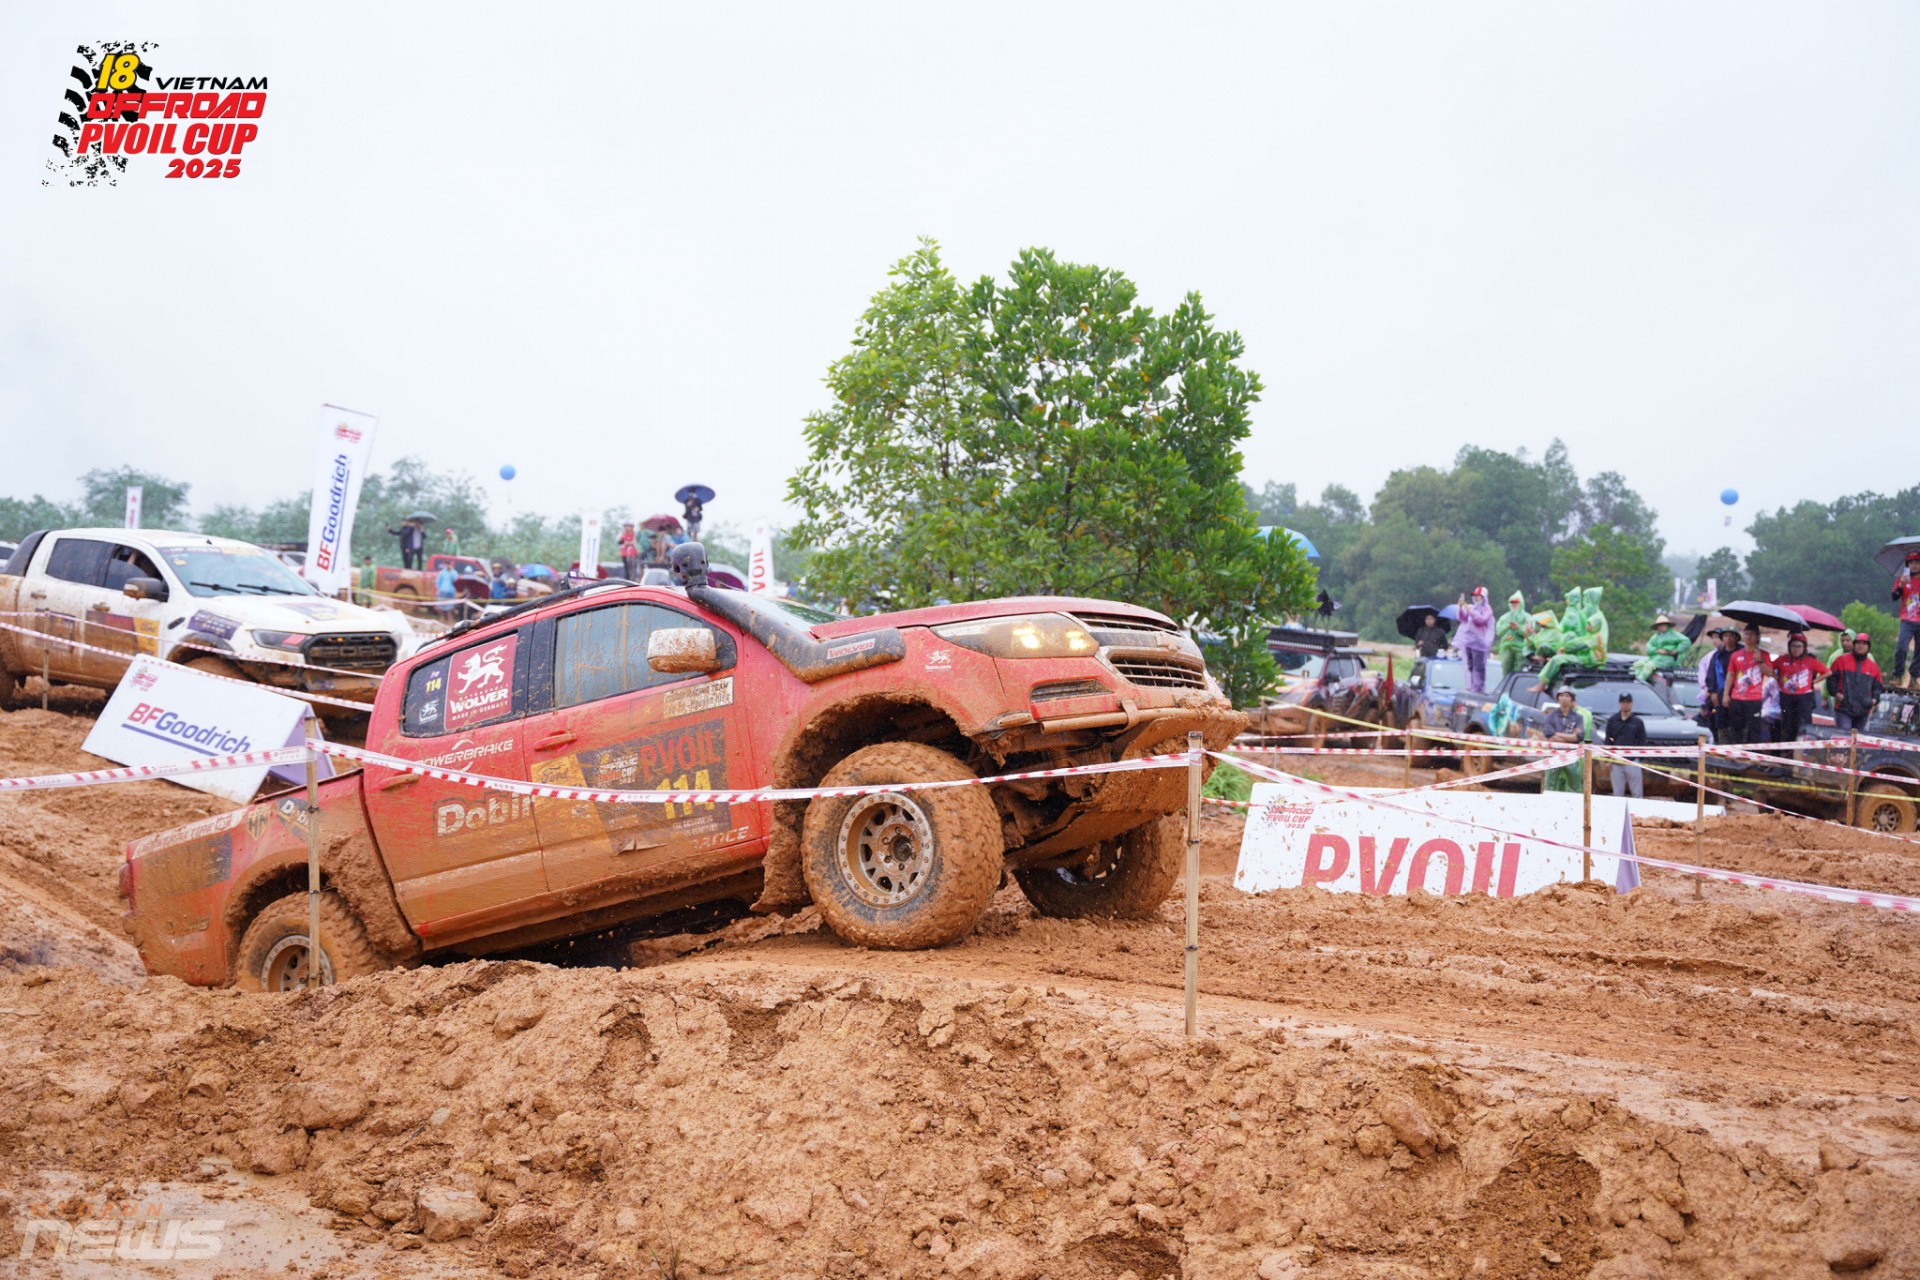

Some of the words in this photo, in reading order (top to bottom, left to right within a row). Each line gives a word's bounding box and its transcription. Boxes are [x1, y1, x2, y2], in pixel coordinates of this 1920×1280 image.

[316, 453, 348, 572] BFGoodrich
[829, 642, 874, 657] WOLVER
[425, 677, 441, 693] 114
[450, 688, 508, 714] WOLVER
[128, 703, 251, 753] BFGoodrich
[451, 712, 469, 721] MADE
[640, 730, 720, 782] PVOIL
[656, 769, 715, 819] 114
